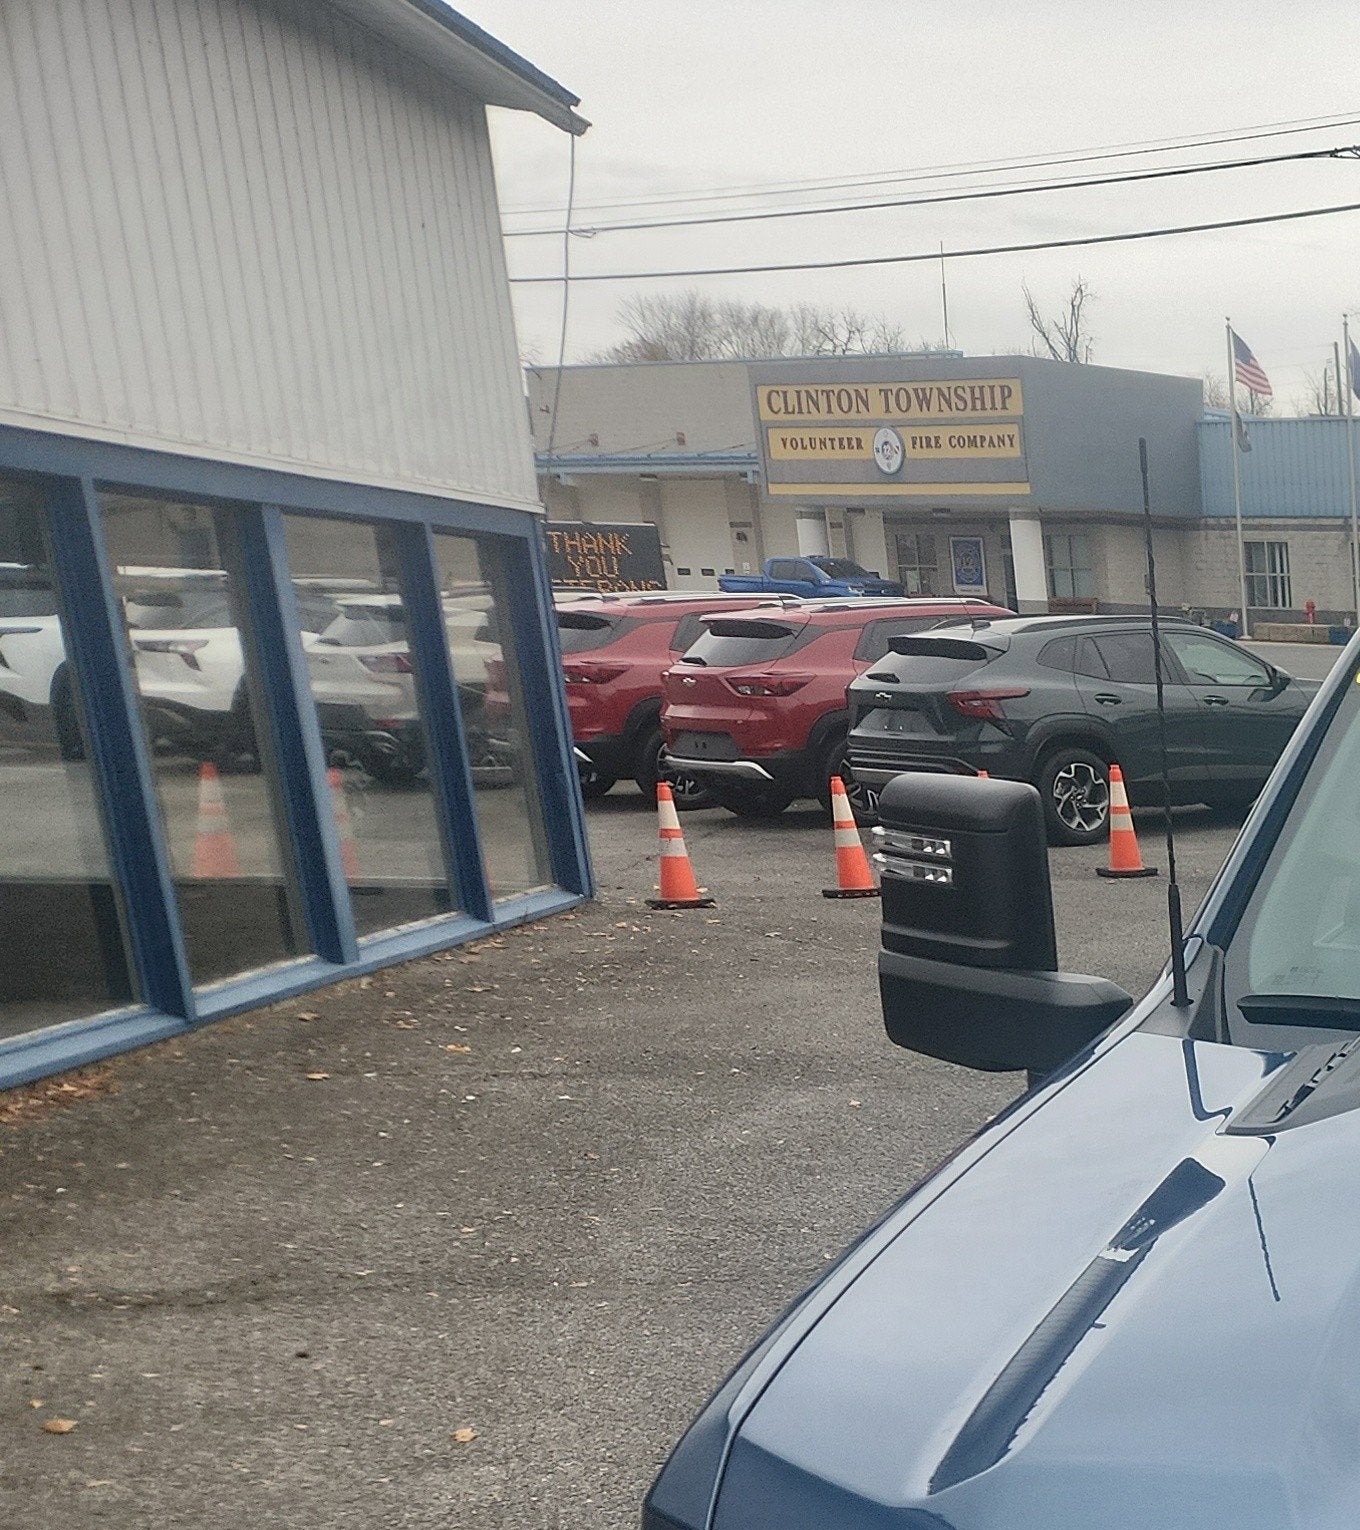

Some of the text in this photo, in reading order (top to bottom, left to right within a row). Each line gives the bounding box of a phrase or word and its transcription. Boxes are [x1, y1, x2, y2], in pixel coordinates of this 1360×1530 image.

[766, 384, 1013, 415] CLINTON TOWNSHIP
[780, 436, 864, 451] VOLUNTEER
[910, 435, 942, 450] FIRE
[949, 434, 1016, 449] COMPANY
[546, 531, 633, 555] THANK
[567, 556, 619, 578] YOU
